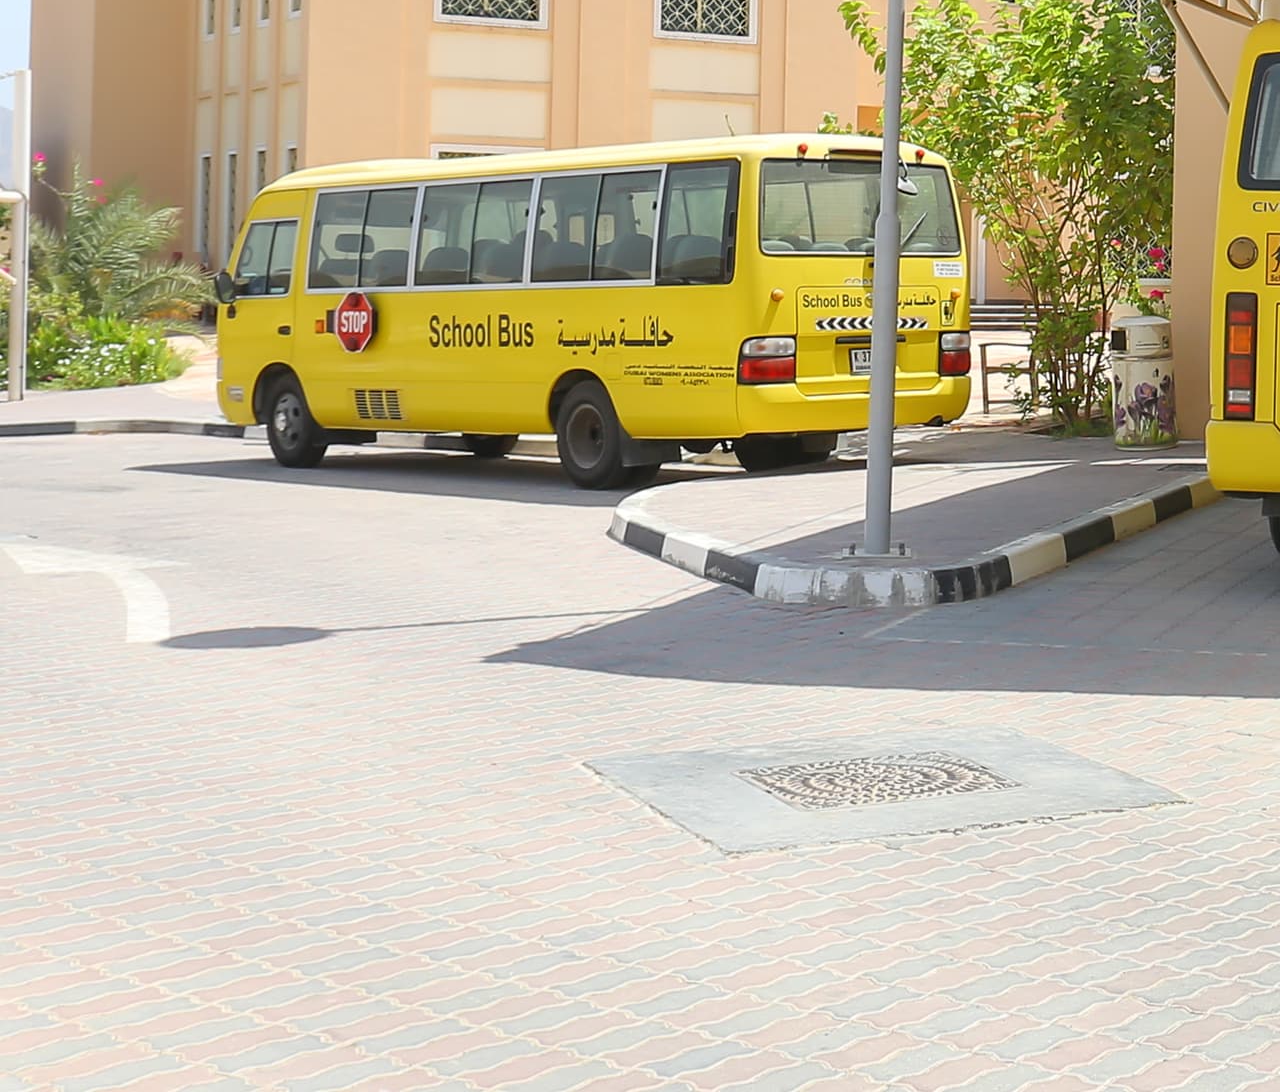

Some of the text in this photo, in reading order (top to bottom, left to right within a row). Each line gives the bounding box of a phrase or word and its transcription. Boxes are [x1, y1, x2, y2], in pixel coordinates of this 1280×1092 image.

[802, 294, 863, 308] School Bus
[340, 311, 368, 334] STOP
[429, 315, 534, 348] School Bus
[557, 316, 674, 356] حافلة مدرسية
